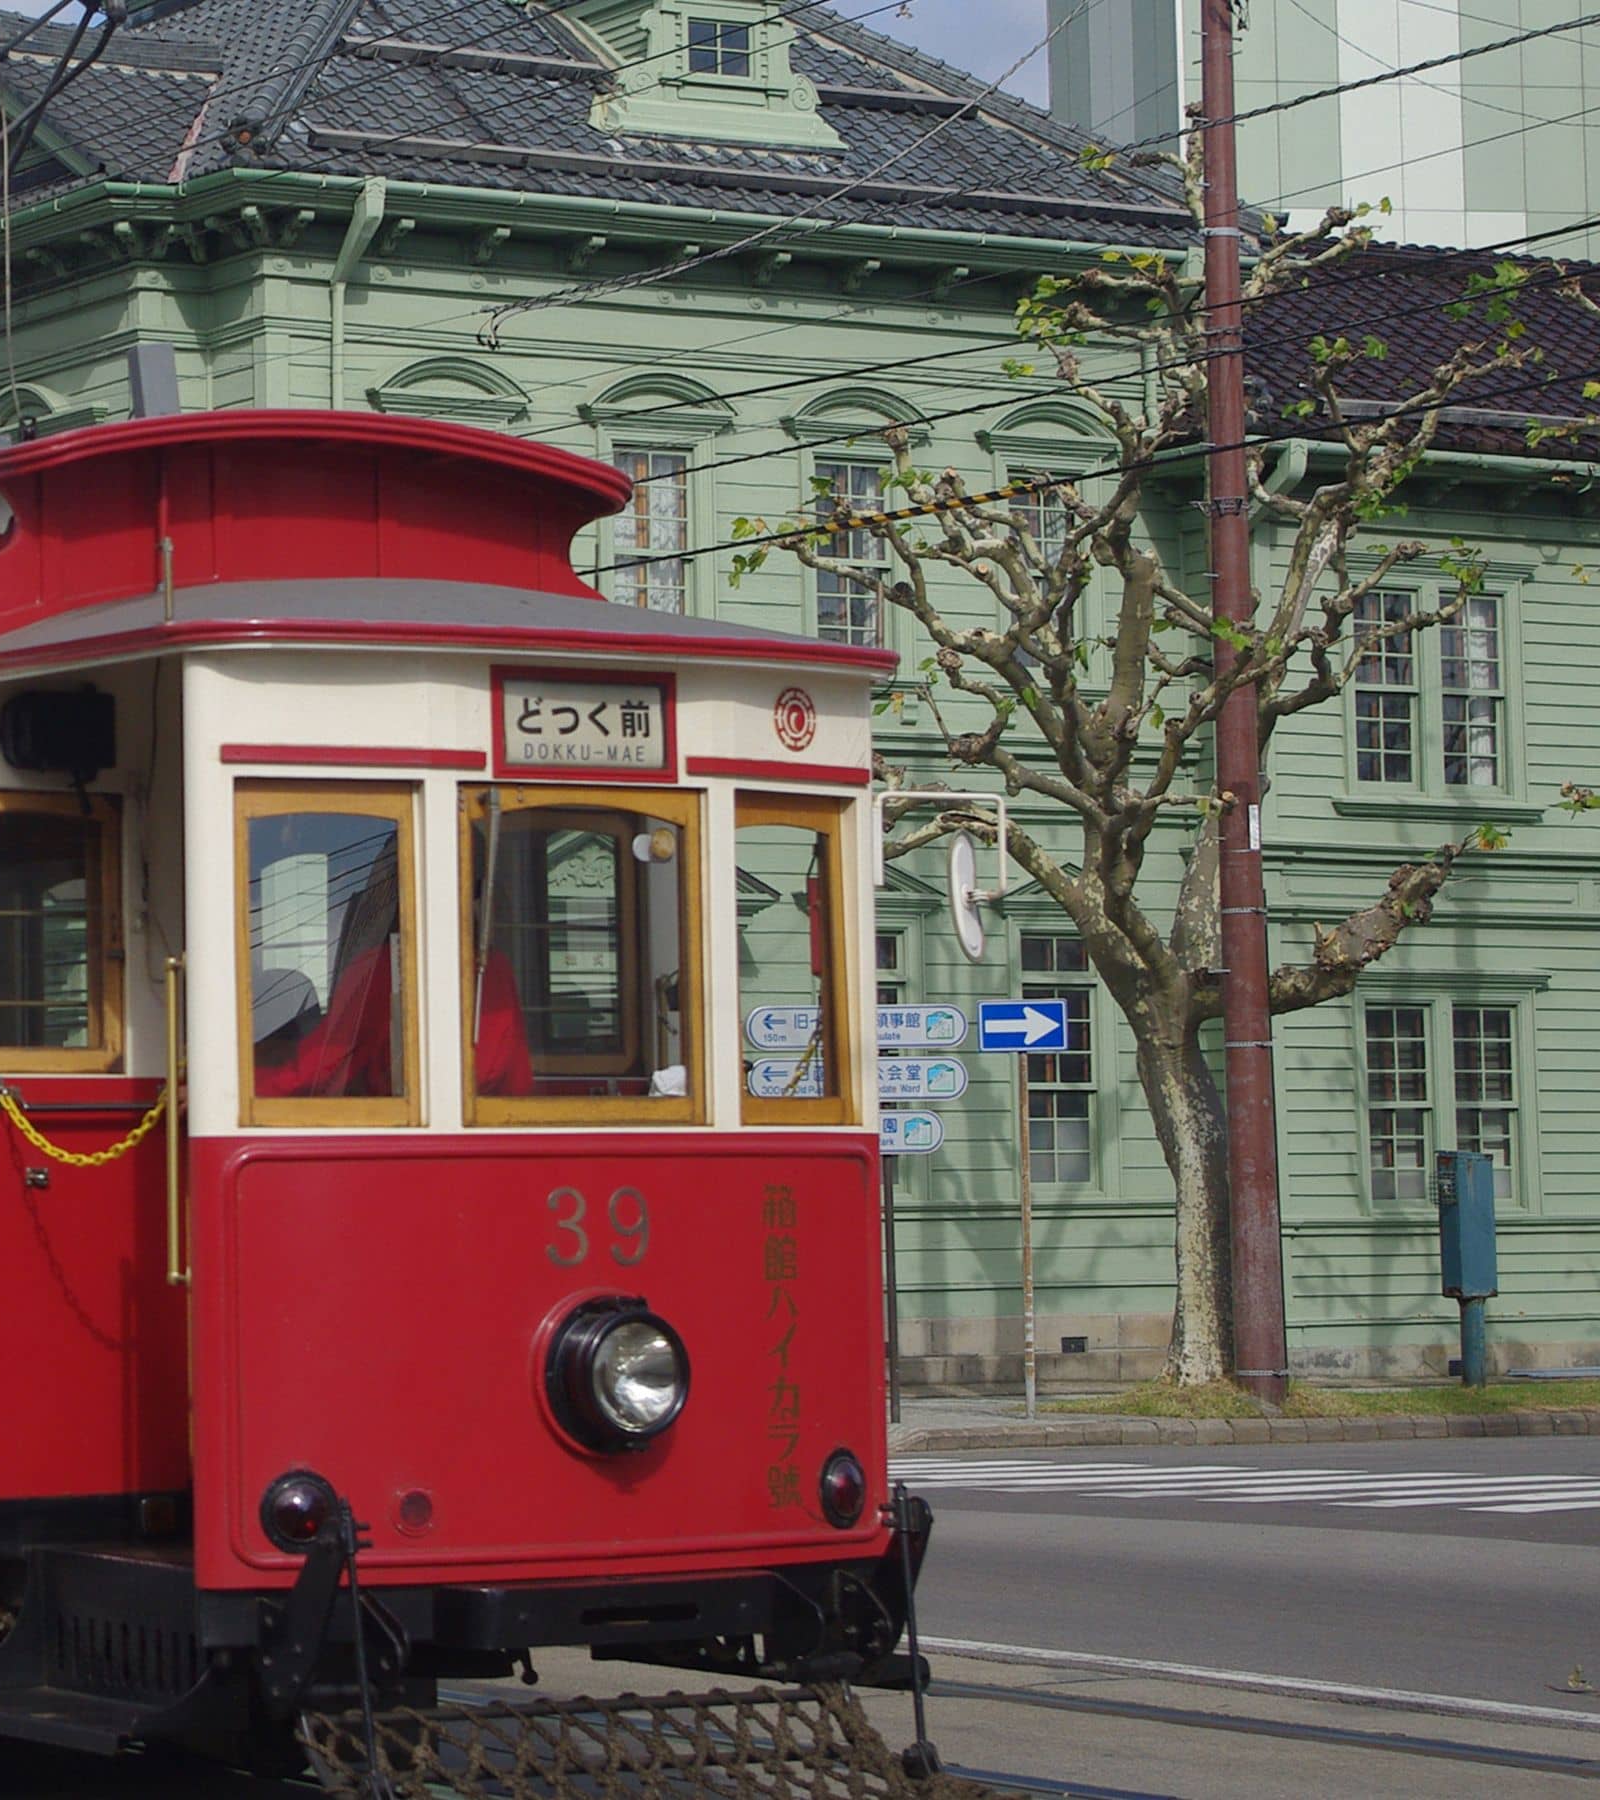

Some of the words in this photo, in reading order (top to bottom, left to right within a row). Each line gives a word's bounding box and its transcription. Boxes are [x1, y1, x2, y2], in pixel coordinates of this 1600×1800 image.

[517, 697, 650, 738] どつく前
[523, 742, 646, 762] DOKKU-MAE
[546, 1186, 649, 1267] 39
